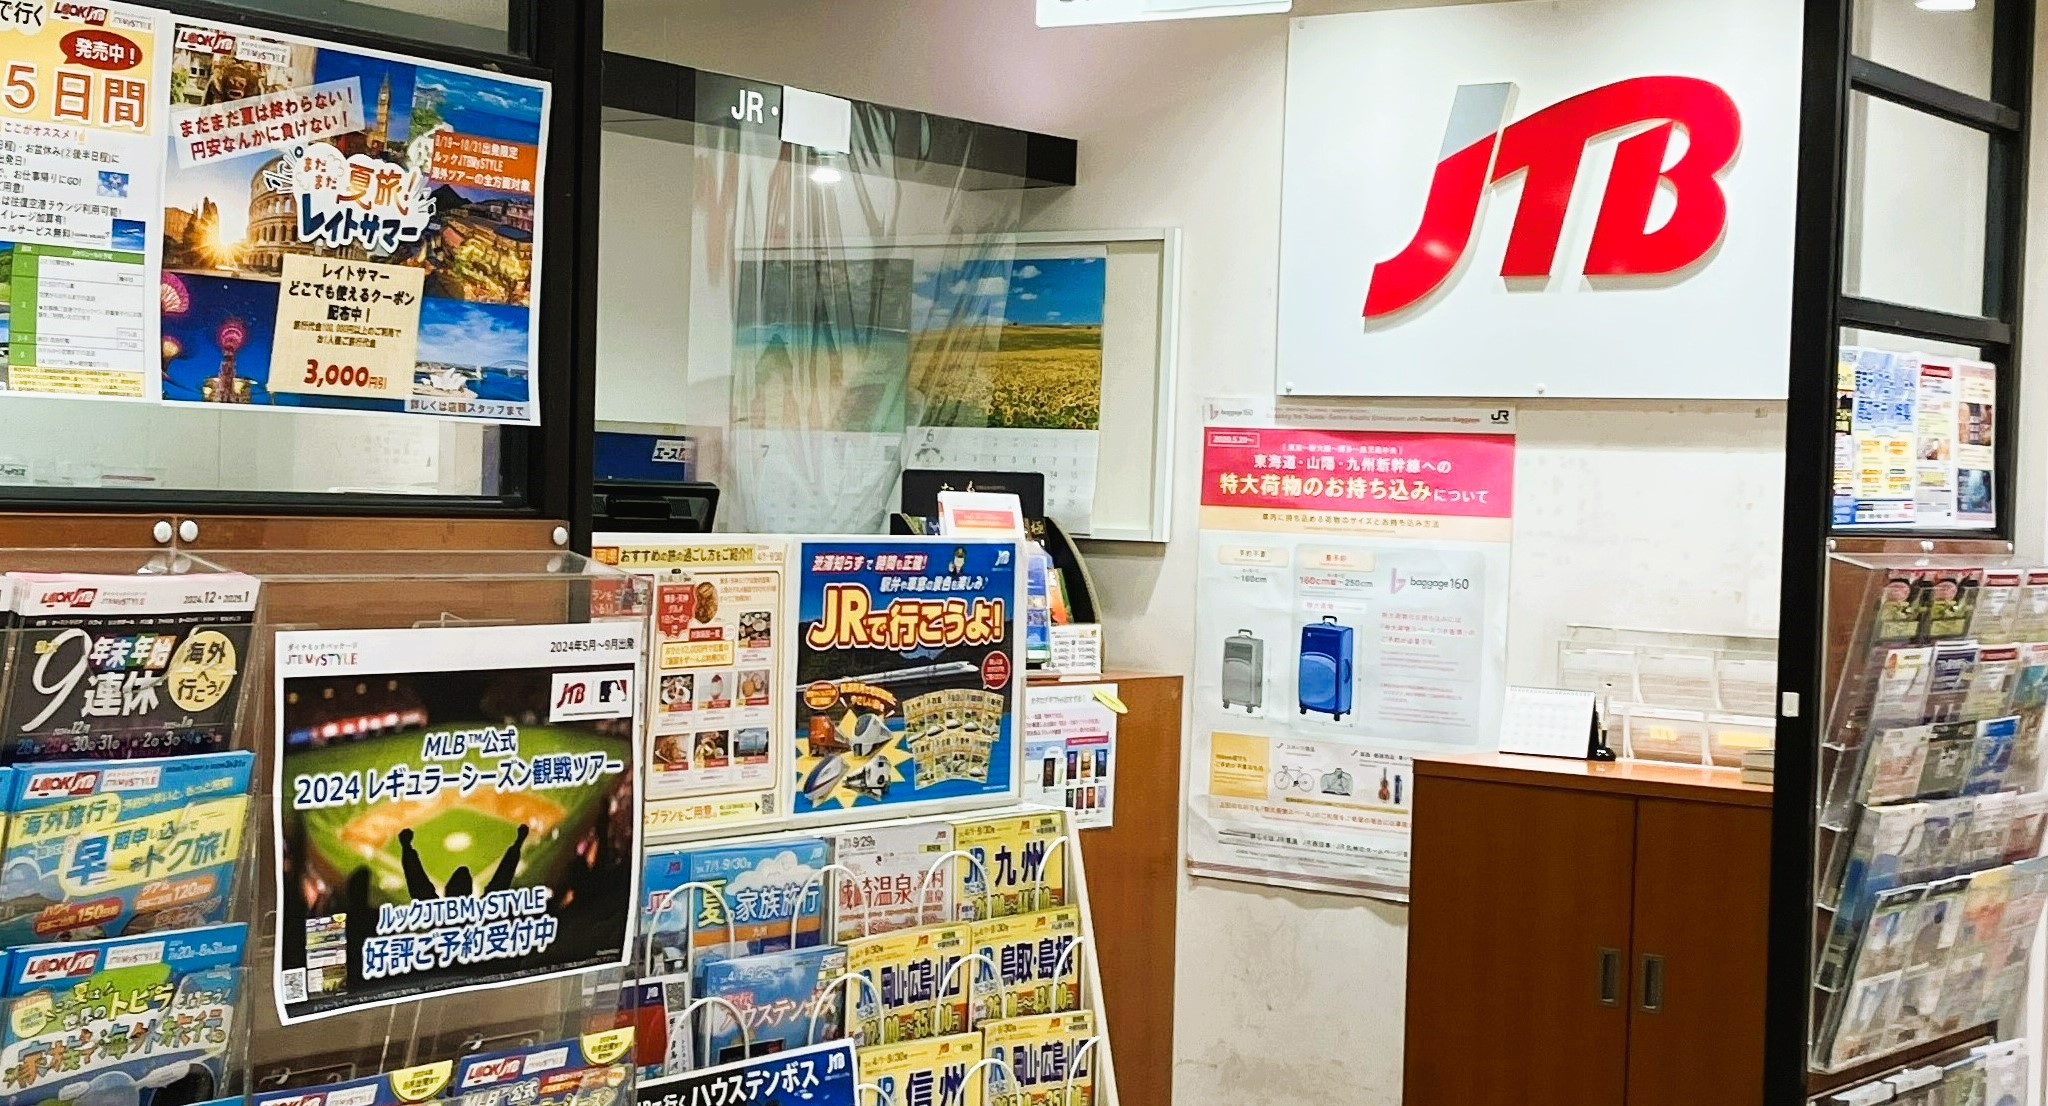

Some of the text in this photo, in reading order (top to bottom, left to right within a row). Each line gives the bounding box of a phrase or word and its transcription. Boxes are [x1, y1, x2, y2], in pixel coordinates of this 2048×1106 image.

[179, 86, 353, 138] まだまだ夏は終わらない!
[189, 110, 349, 160] 円安なんかに負けない!
[301, 193, 419, 247] レイトサマー
[1363, 76, 1742, 317] JTB
[322, 263, 390, 281] レイトサマー
[1490, 409, 1510, 421] JR
[1253, 453, 1452, 474] 東海道・山陽・九州新幹線への
[1219, 472, 1490, 505] 特大荷物のお持ち込みについて
[807, 585, 1004, 648] JRで行こうよ!
[90, 635, 174, 669] 年末年始
[81, 671, 164, 718] 連休
[297, 754, 624, 805] 2024 レギュラーシーズン観戦ツアー
[994, 839, 1046, 888] 九州
[379, 887, 547, 931] ルックJTBMySTYLE
[364, 918, 557, 972] 好評ご予約受付中
